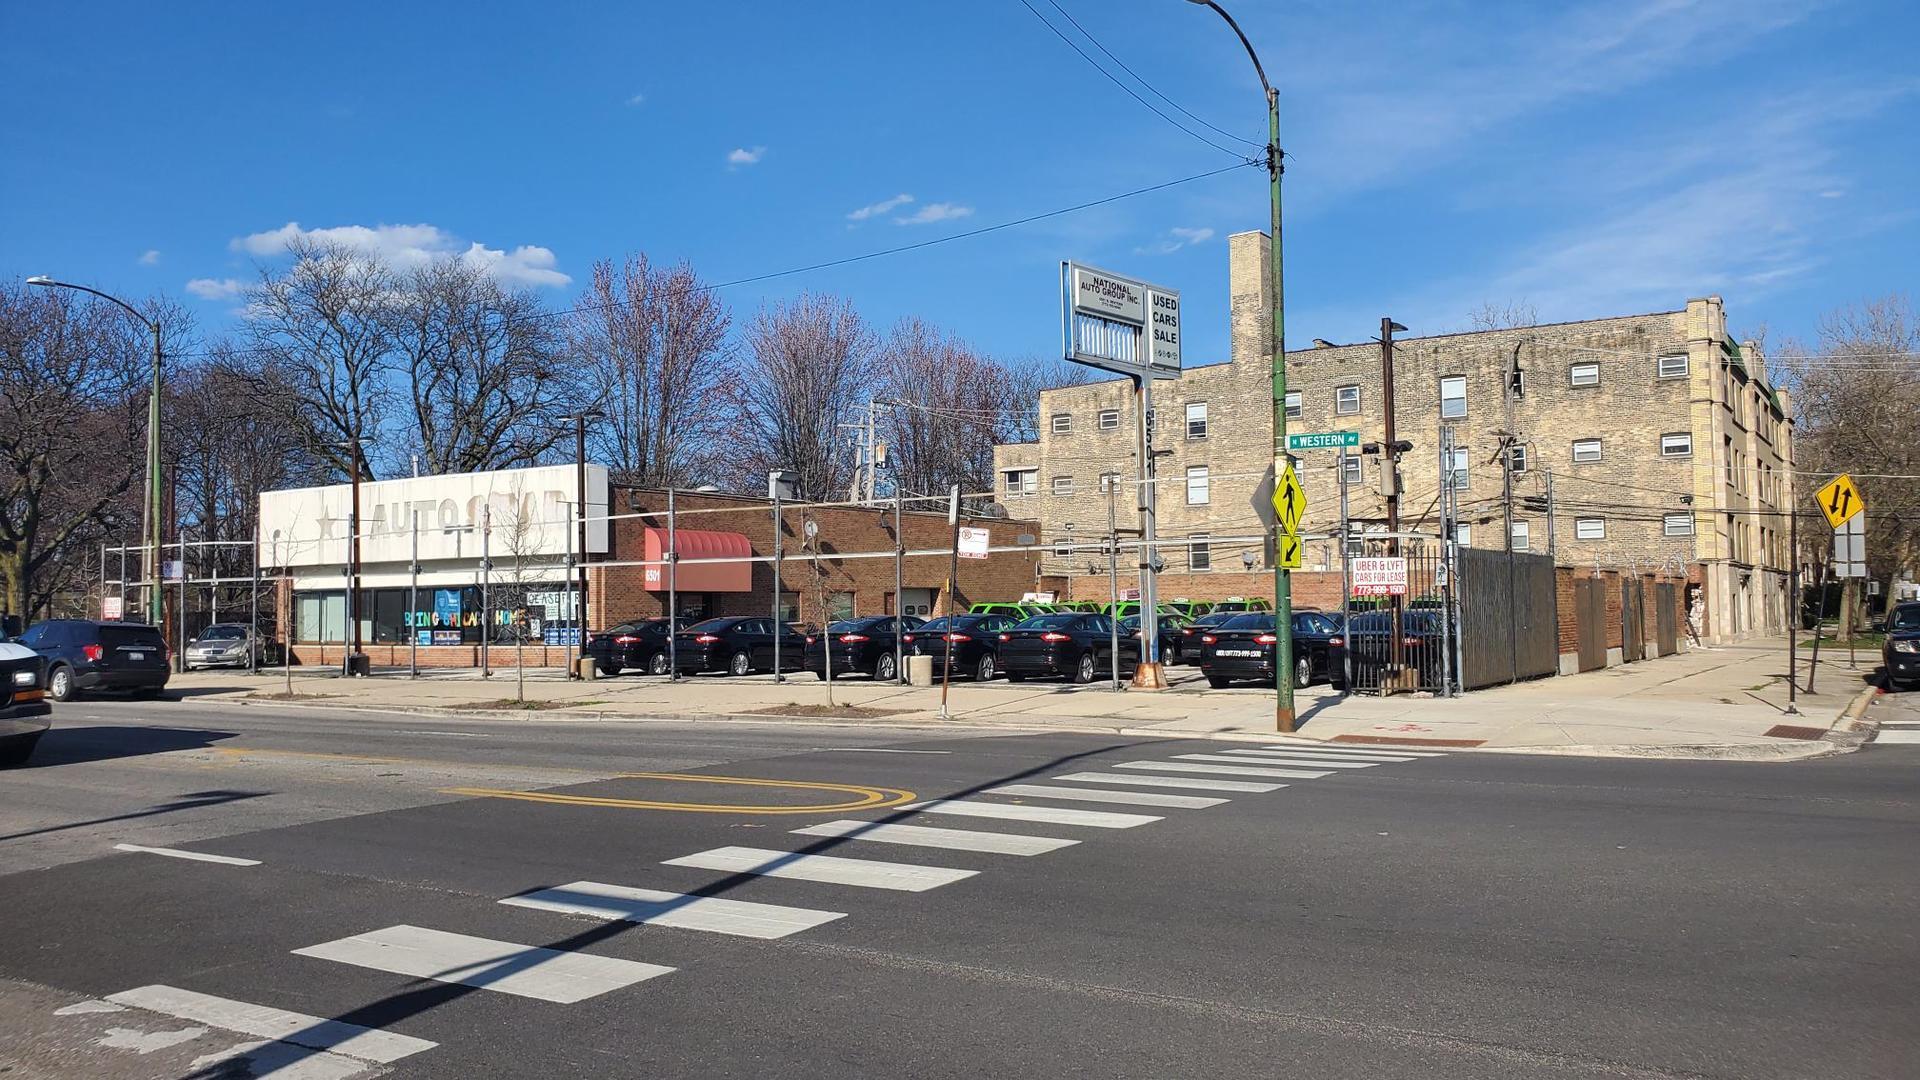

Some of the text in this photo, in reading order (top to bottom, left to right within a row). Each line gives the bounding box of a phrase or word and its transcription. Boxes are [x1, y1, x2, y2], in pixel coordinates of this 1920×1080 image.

[1081, 282, 1101, 294] AUTO
[1102, 288, 1126, 300] GROUP
[1093, 277, 1132, 295] NATIONAL
[1153, 294, 1177, 311] USED
[1152, 312, 1177, 328] CARS
[1154, 329, 1177, 345] SALE
[1300, 435, 1345, 447] WESTERN
[1356, 561, 1404, 571] UBER & LYFT
[1355, 572, 1405, 582] CARS FOR LEASE
